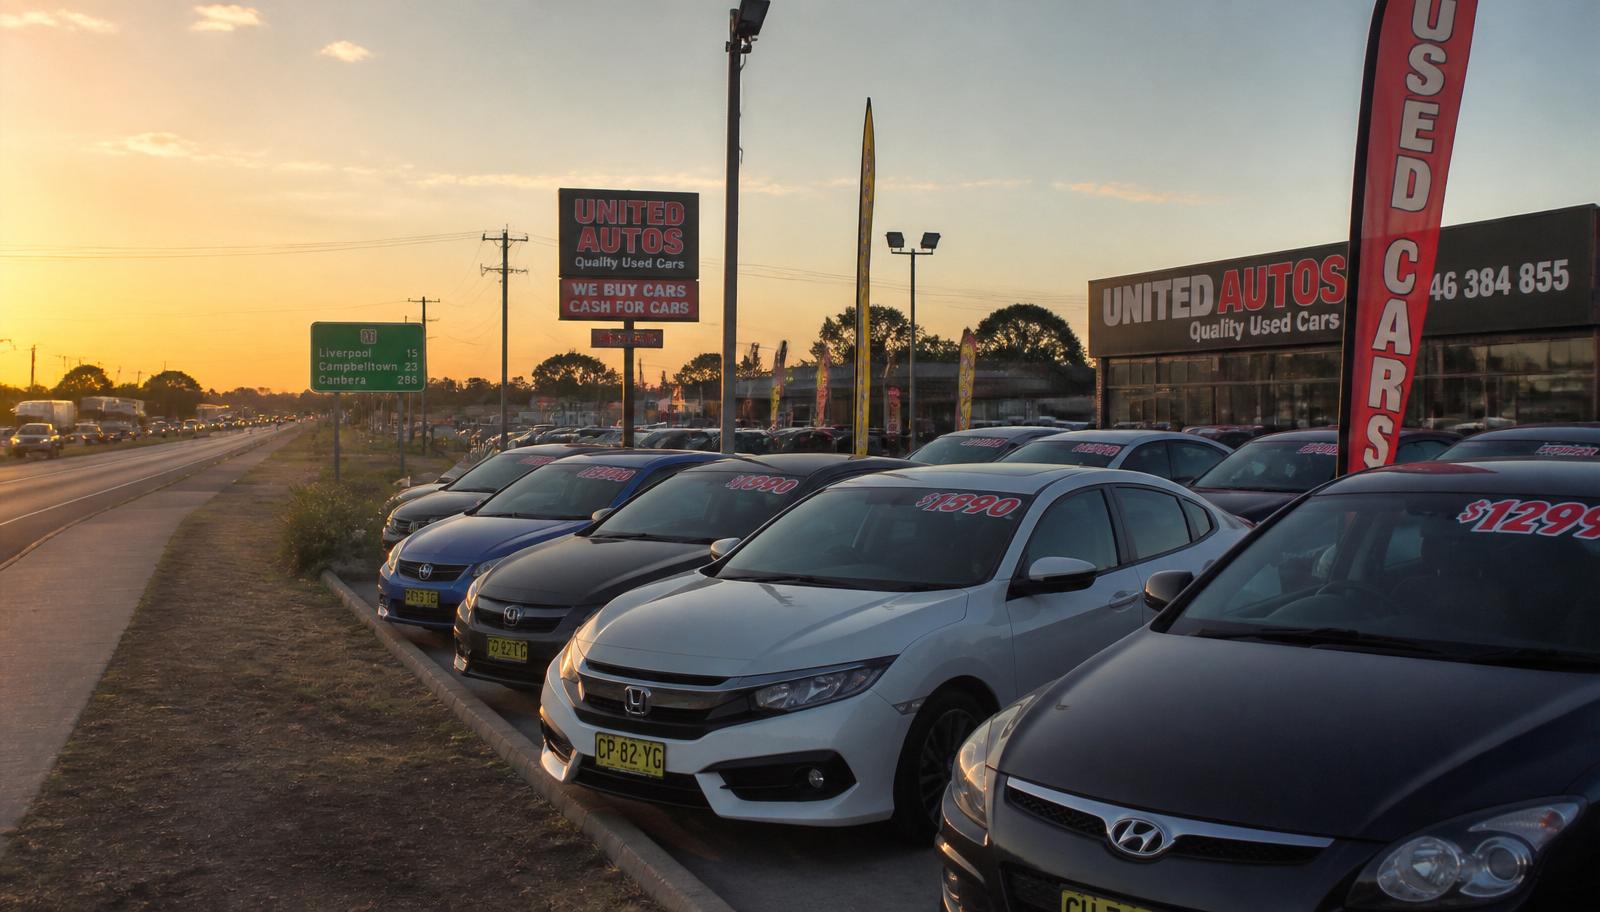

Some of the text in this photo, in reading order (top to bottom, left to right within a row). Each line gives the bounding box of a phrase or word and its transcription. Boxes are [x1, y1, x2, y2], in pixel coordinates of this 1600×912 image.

[574, 198, 685, 226] UNITED
[576, 226, 684, 255] AUTOS
[1363, 0, 1458, 468] USED CARS
[575, 256, 685, 270] Quality Used Cars
[572, 283, 686, 297] WE BUY CARS
[1103, 254, 1347, 327] UNITED AUTOS
[1463, 265, 1511, 298] 384
[1519, 259, 1570, 294] 855
[569, 300, 689, 314] CASH FOR CARS
[1189, 310, 1340, 343] Quality Used Cars
[319, 348, 418, 359] Liverpool 15
[319, 362, 418, 373] Campbelltown 23
